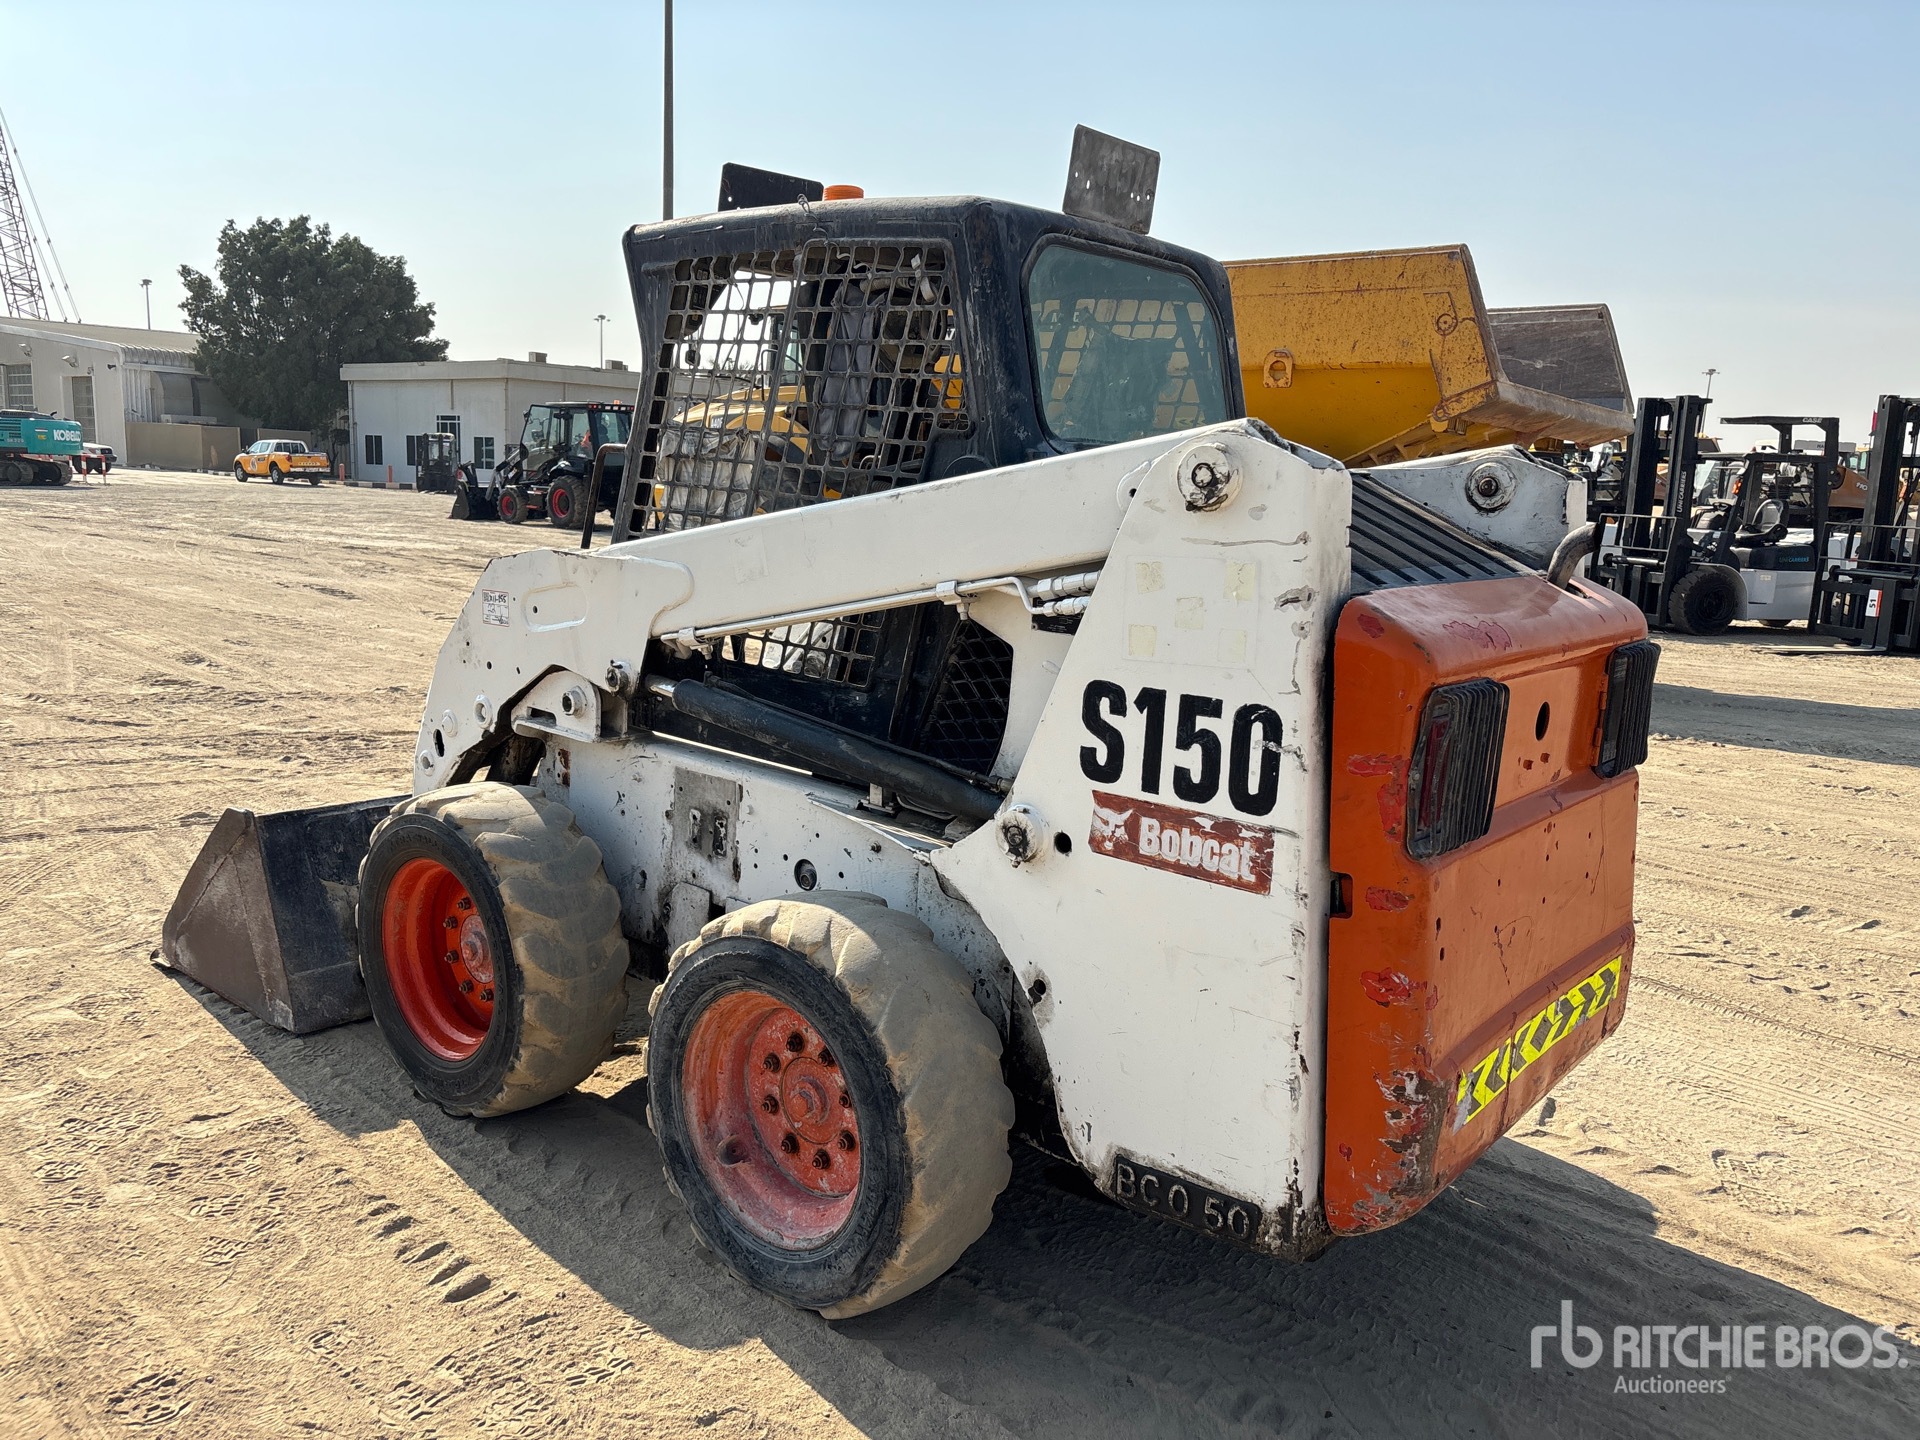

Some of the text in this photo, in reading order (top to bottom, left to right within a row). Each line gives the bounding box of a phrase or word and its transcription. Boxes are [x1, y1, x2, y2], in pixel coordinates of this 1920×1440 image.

[1869, 598, 1877, 609] 51
[1080, 679, 1283, 816] S150
[1138, 816, 1256, 882] Bobcat
